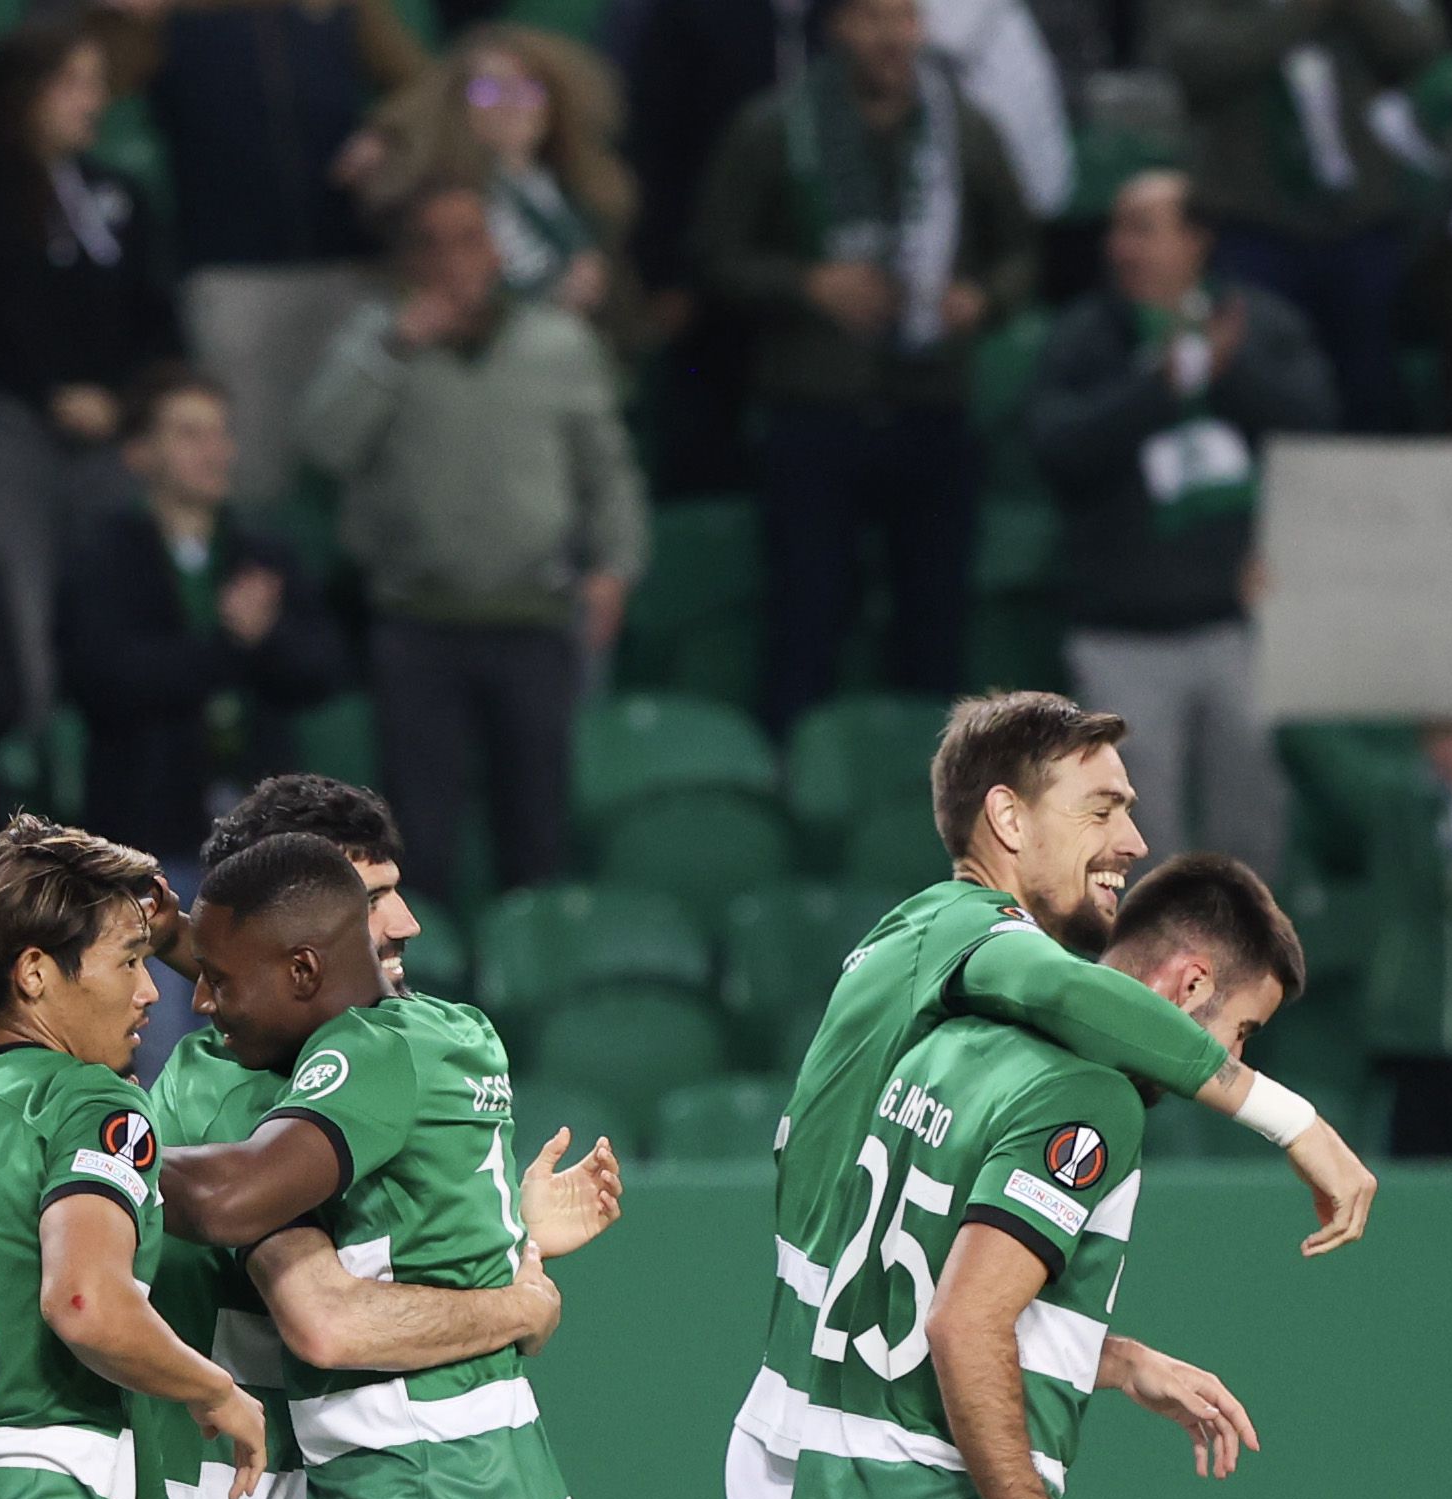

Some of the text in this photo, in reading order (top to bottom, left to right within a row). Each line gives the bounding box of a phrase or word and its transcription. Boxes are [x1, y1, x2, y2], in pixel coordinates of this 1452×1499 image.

[76, 1156, 143, 1202] FOUNDATION
[1010, 1178, 1083, 1226] FOUNDATION
[811, 1135, 955, 1382] 25
